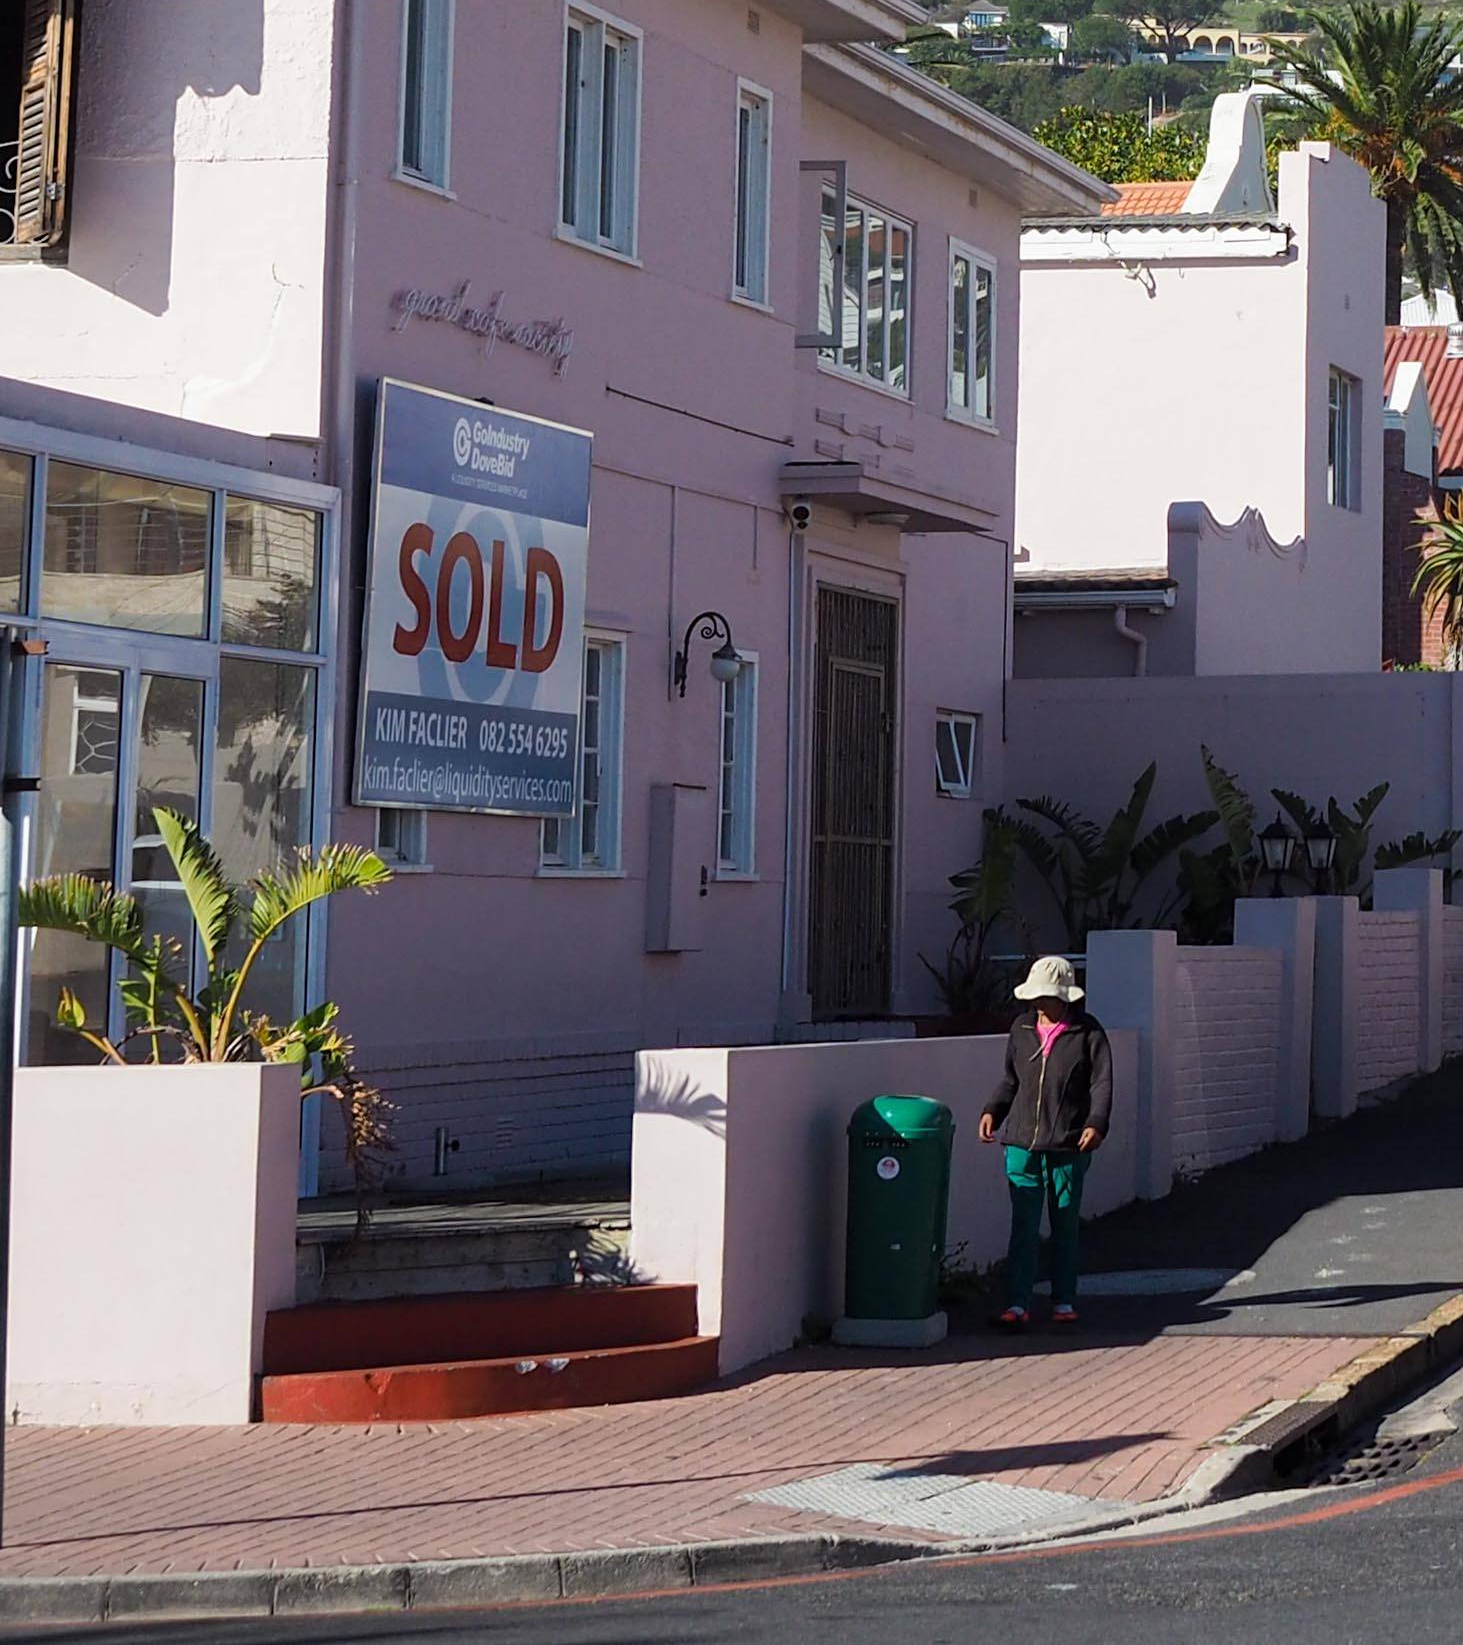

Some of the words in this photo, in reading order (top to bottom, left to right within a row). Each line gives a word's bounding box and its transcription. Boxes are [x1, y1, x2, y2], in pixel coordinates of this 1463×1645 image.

[471, 447, 515, 478] DoveBid
[473, 421, 530, 461] GoIndustry
[393, 522, 564, 673] SOLD
[375, 707, 406, 743] KIM
[408, 711, 468, 750] FACLIER
[479, 720, 504, 753] 082
[507, 722, 533, 756] 554
[535, 726, 568, 759] 6295
[363, 755, 572, 805] kim.faclier@liquidityservices.com
